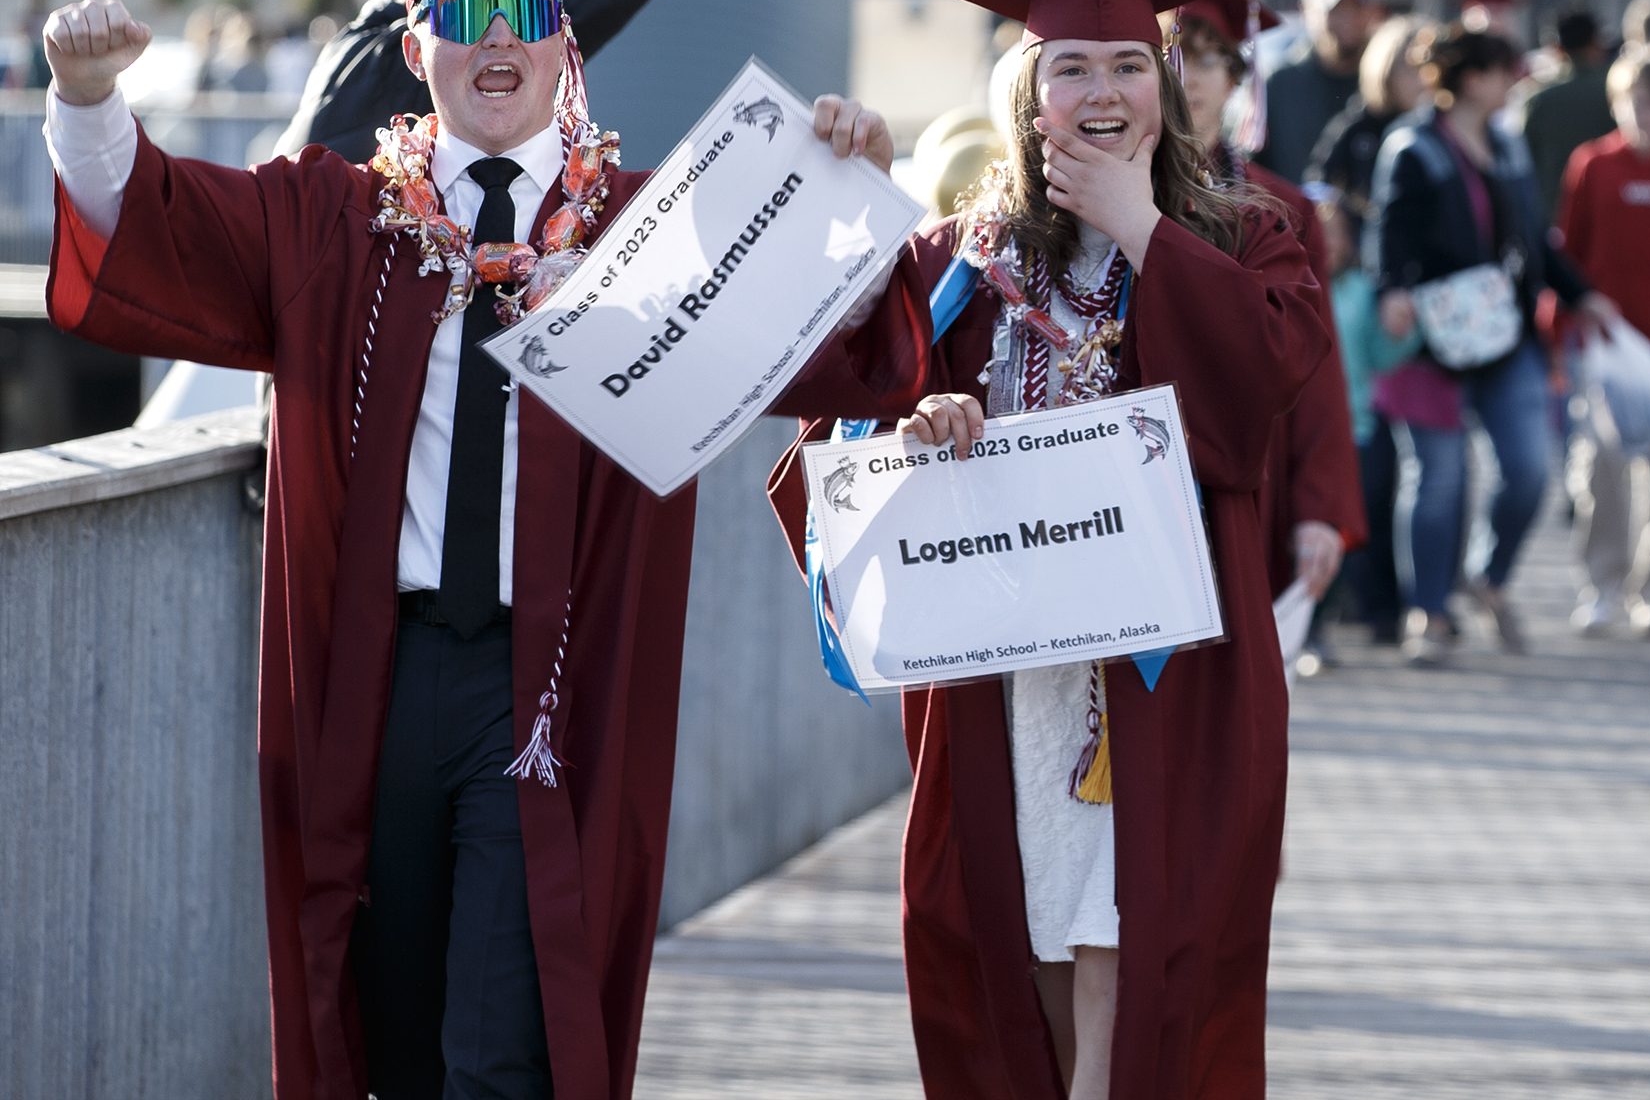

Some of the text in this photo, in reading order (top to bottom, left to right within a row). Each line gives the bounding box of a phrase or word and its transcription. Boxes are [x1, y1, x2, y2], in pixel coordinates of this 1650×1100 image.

[546, 291, 600, 337] Class
[600, 263, 619, 288] of
[617, 218, 659, 268] 2023
[656, 128, 735, 214] Graduate
[599, 170, 804, 398] David Rasmussen
[868, 449, 930, 475] Class
[937, 445, 956, 463] of
[1017, 420, 1120, 451] Graduate
[899, 506, 1125, 566] Logenn Merrill
[903, 649, 964, 671] Ketchikan
[965, 645, 995, 664] High
[996, 640, 1038, 659] School
[1050, 629, 1117, 651] Ketchikan,
[1119, 621, 1161, 640] Alaska
